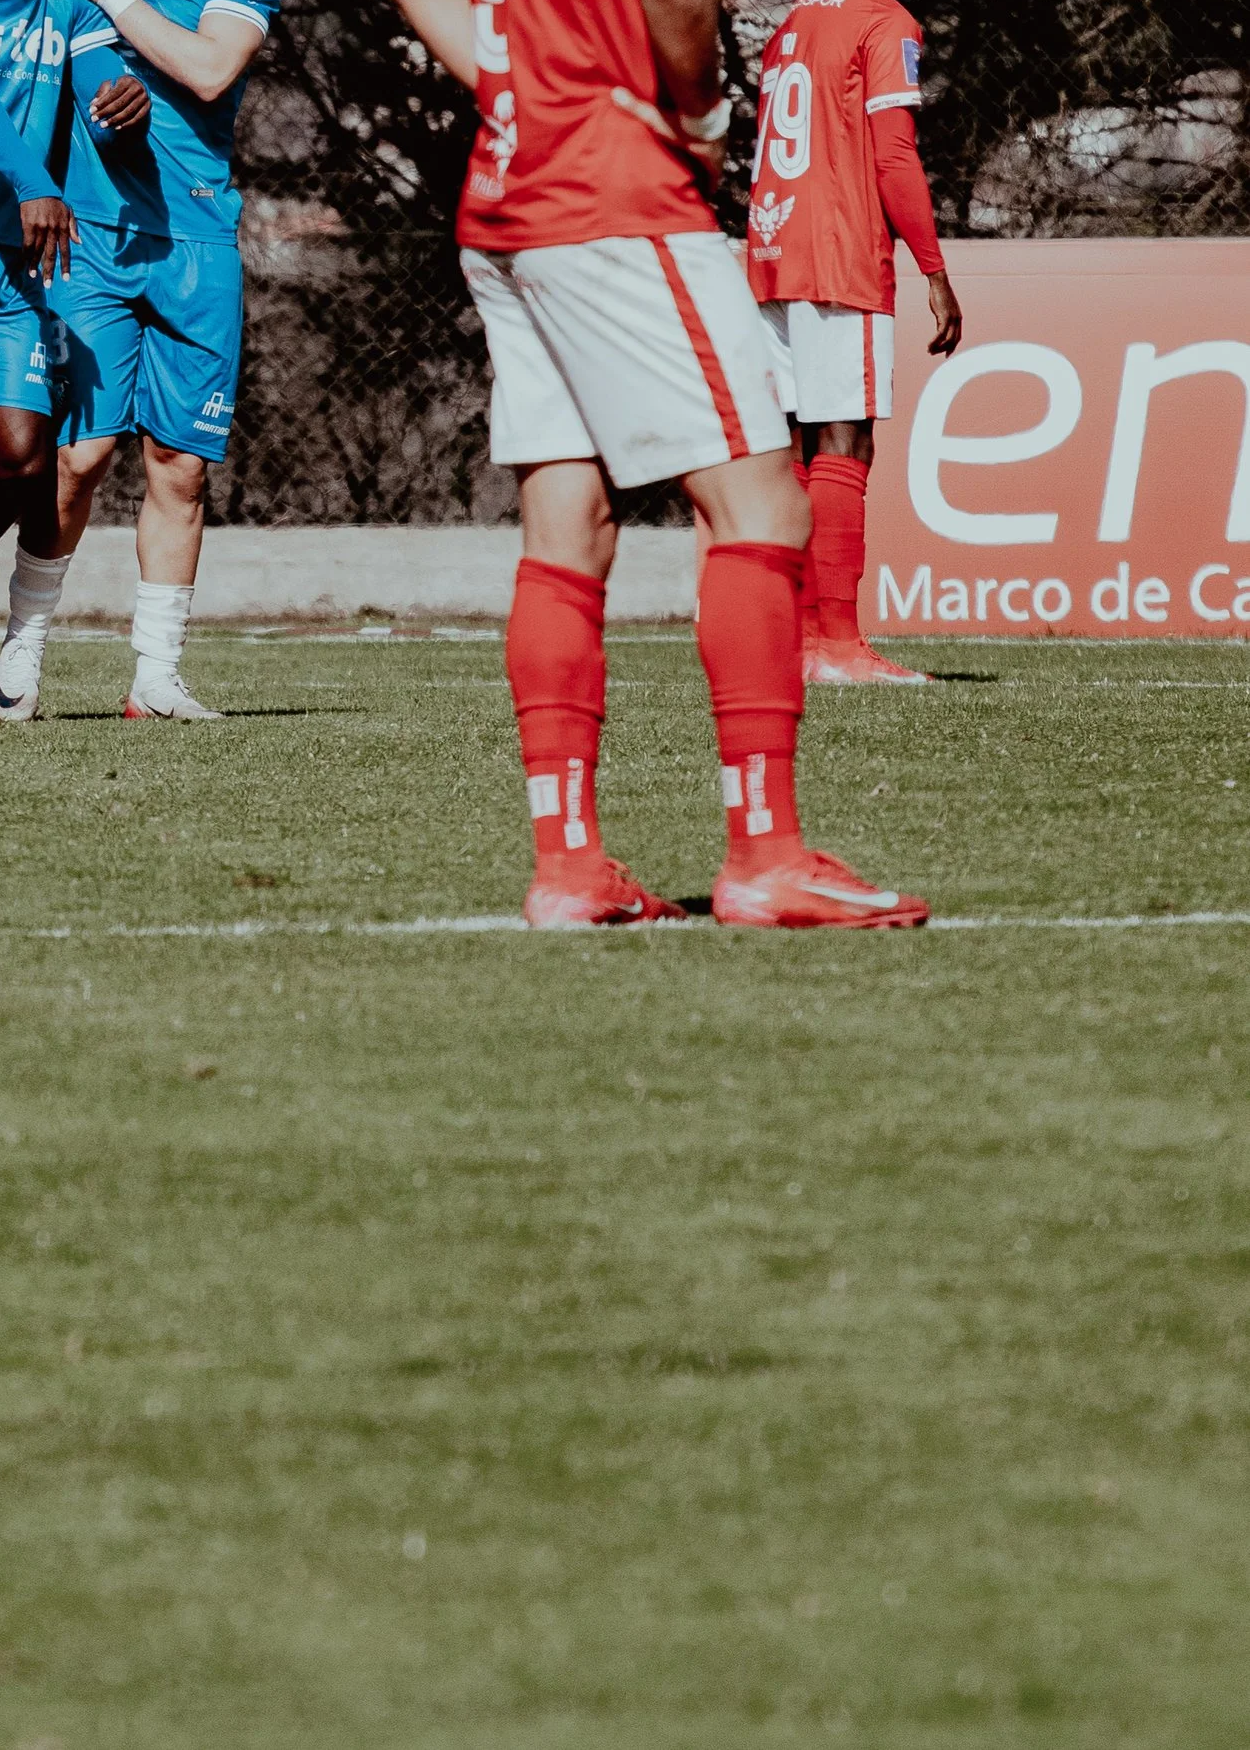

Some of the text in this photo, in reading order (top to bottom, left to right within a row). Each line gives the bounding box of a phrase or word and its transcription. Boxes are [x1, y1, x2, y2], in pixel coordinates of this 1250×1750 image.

[751, 62, 813, 180] 79
[878, 563, 1073, 623] Marco
[1091, 560, 1171, 623] de
